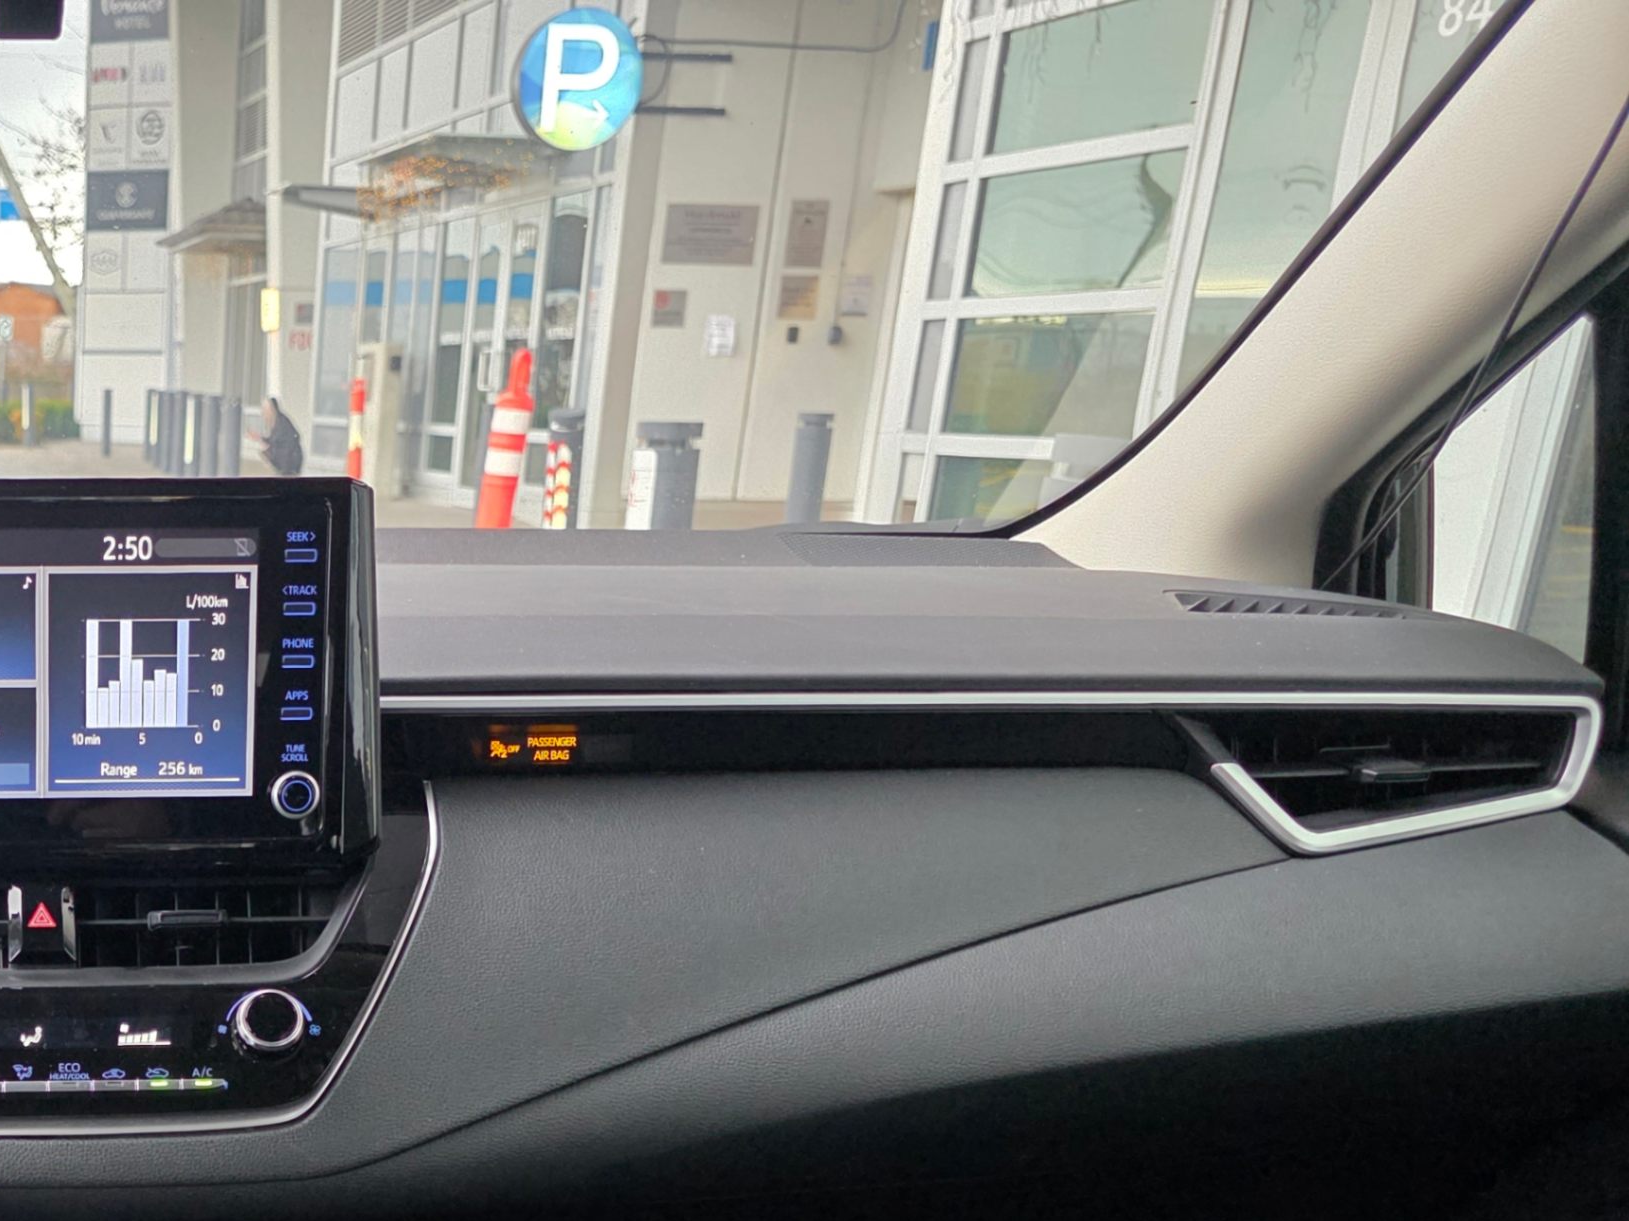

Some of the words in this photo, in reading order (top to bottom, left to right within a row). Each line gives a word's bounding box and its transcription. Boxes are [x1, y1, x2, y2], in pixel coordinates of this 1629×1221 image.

[540, 22, 620, 132] P
[103, 536, 153, 561] 2:50
[186, 594, 228, 609] L/100km
[212, 613, 226, 625] 30
[282, 638, 314, 649] PHONE
[211, 649, 225, 661] 20
[211, 685, 224, 696] 10
[285, 690, 309, 701] APPS
[212, 720, 221, 731] 0
[72, 733, 84, 745] 10
[84, 733, 101, 745] min
[139, 733, 146, 745] 5
[194, 733, 203, 744] 0
[527, 737, 577, 747] PASSENGER
[286, 744, 305, 753] TUNE
[281, 753, 308, 762] SCROLL
[533, 751, 550, 761] AIR
[551, 751, 569, 761] BAG
[101, 764, 137, 777] Range
[158, 763, 186, 775] 256
[188, 764, 203, 775] km
[58, 1062, 81, 1073] ECO
[192, 1067, 213, 1078] A/C
[49, 1072, 90, 1080] HEAT/COOL
